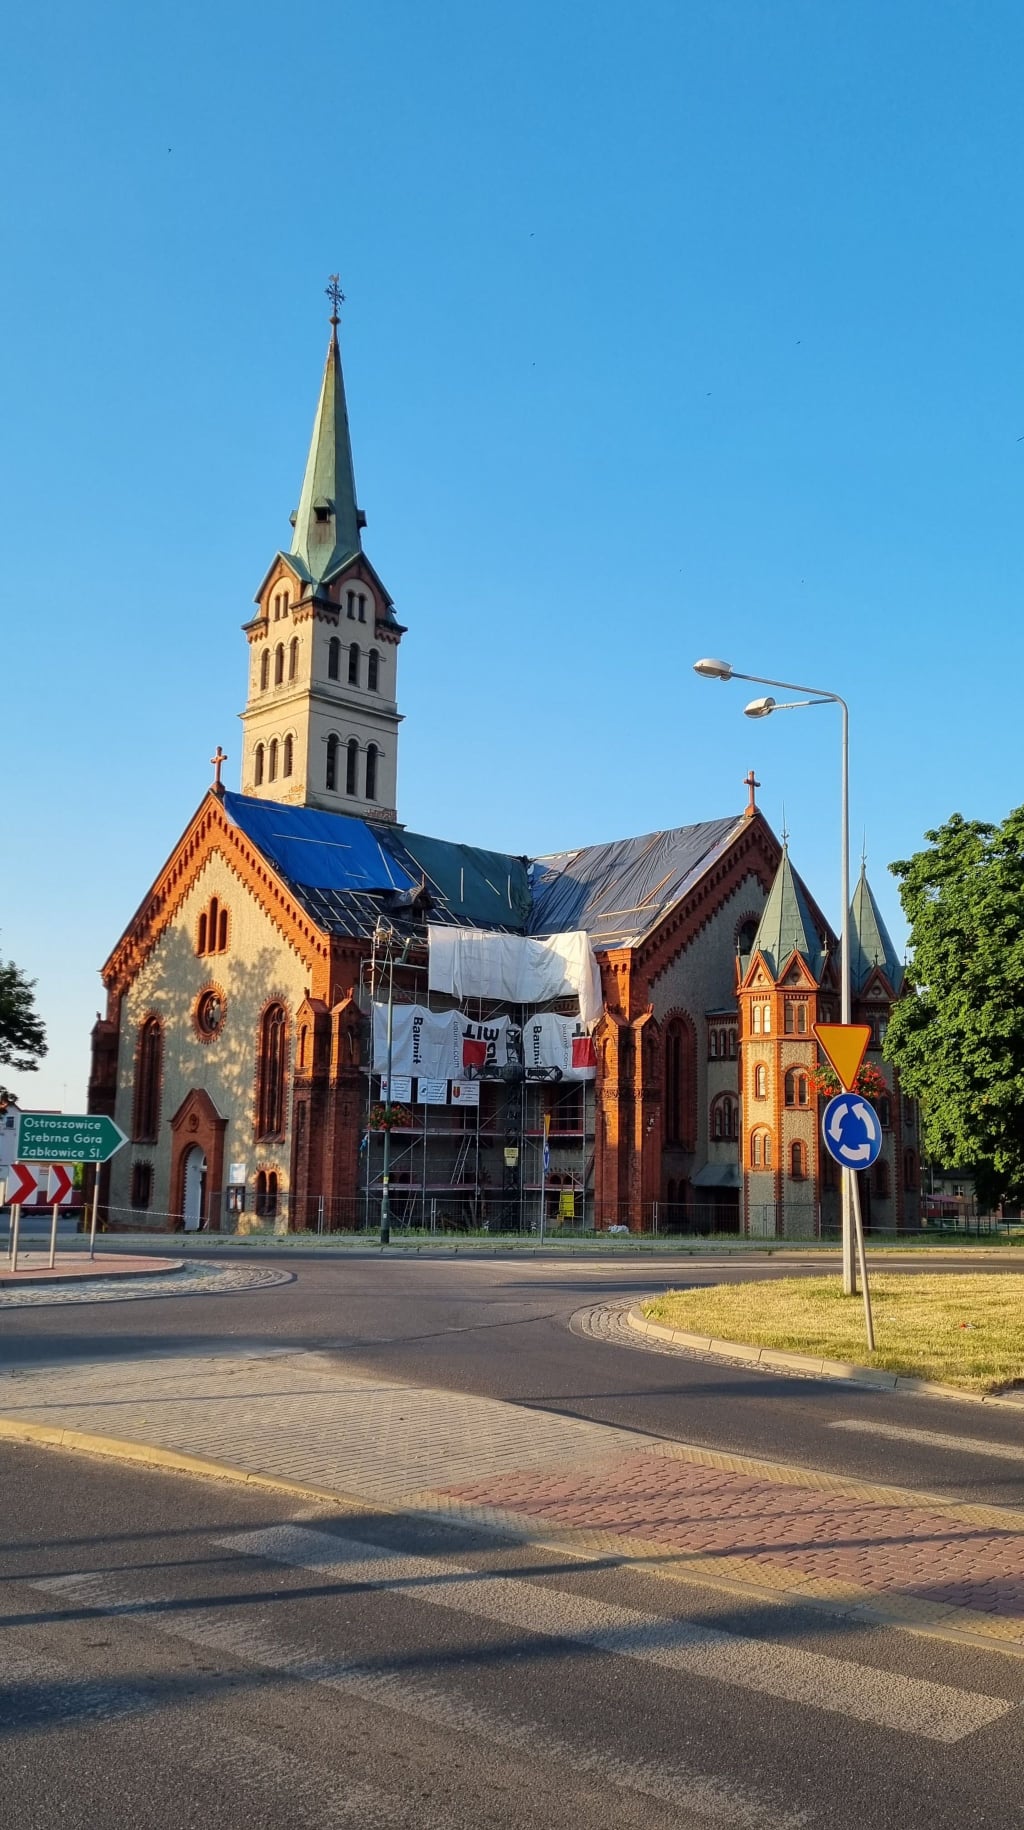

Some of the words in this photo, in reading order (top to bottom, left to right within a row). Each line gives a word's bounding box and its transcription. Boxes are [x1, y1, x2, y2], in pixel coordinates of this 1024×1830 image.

[413, 1016, 424, 1065] Baumit
[533, 1026, 543, 1066] Baumi
[23, 1117, 102, 1130] Ostroszowice
[23, 1131, 70, 1144] Srebrna
[73, 1132, 103, 1144] Góra
[22, 1146, 85, 1159] Ząbkowice
